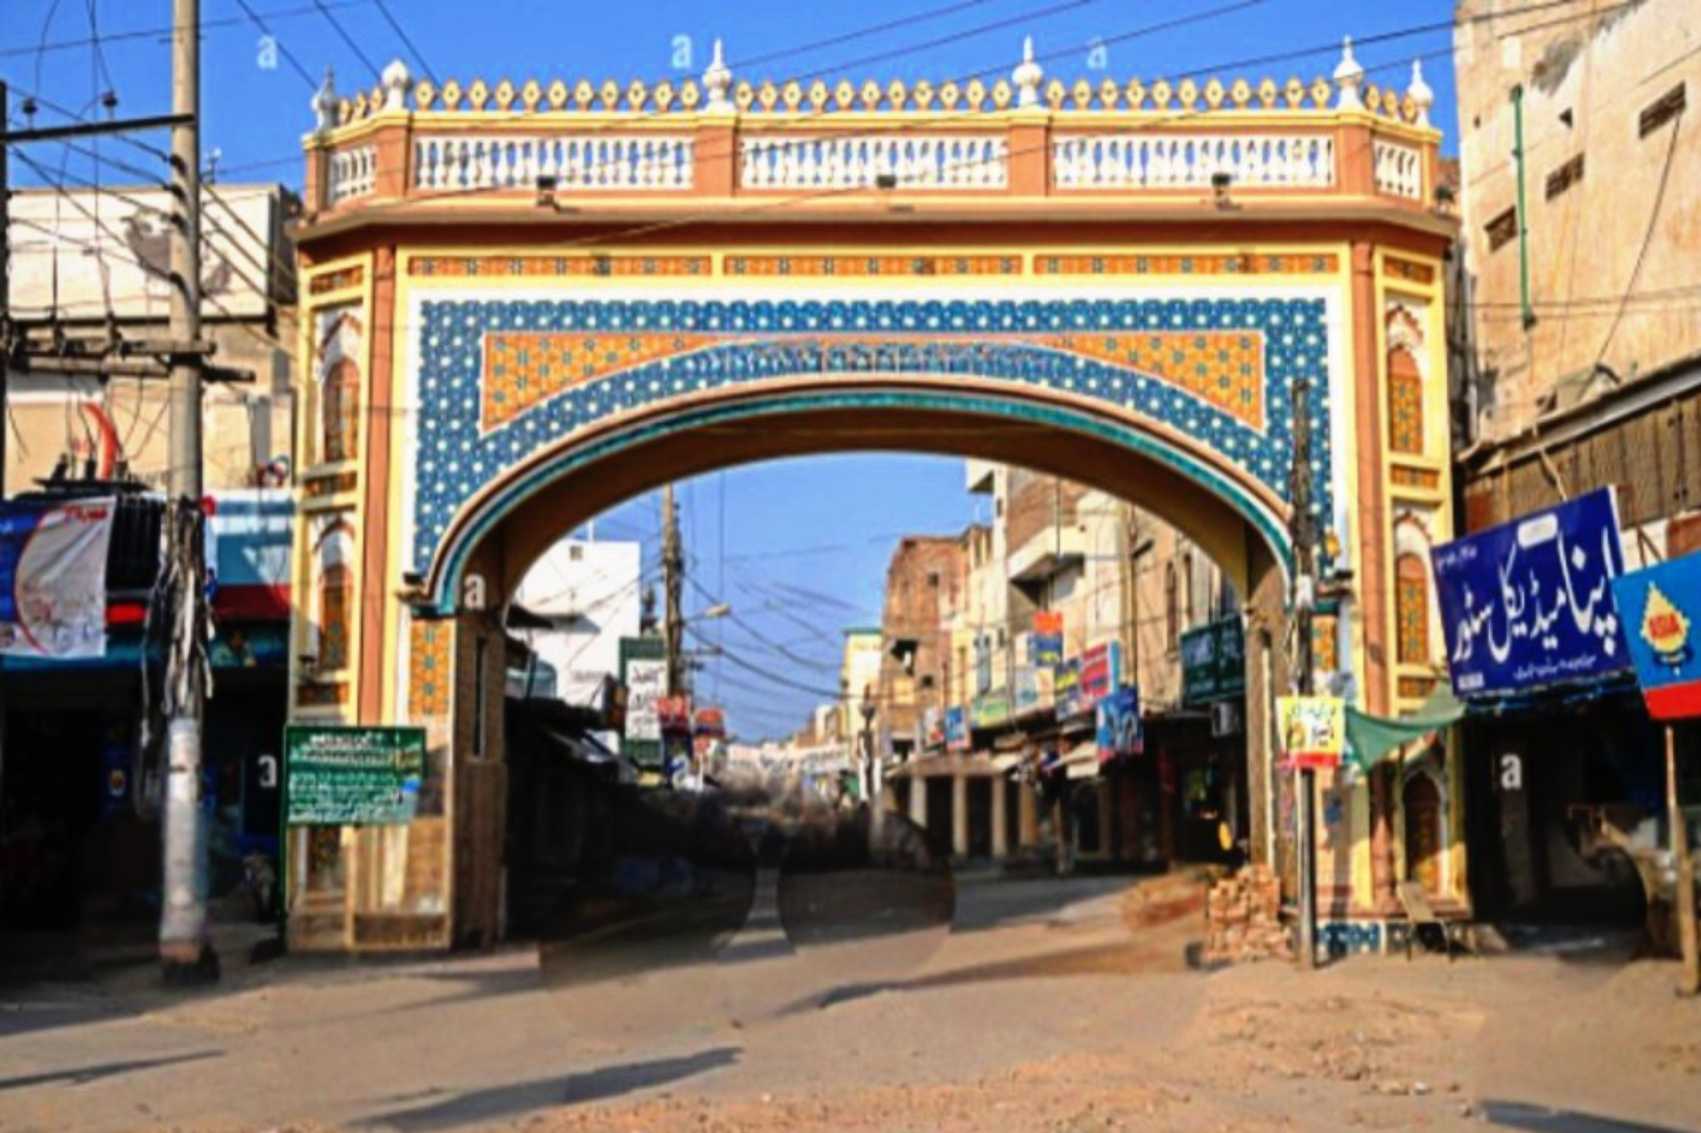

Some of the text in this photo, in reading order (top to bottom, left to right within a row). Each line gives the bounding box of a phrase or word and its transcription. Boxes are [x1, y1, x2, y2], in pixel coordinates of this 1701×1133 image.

[1452, 526, 1617, 663] اپنا میڈیکل سٹور
